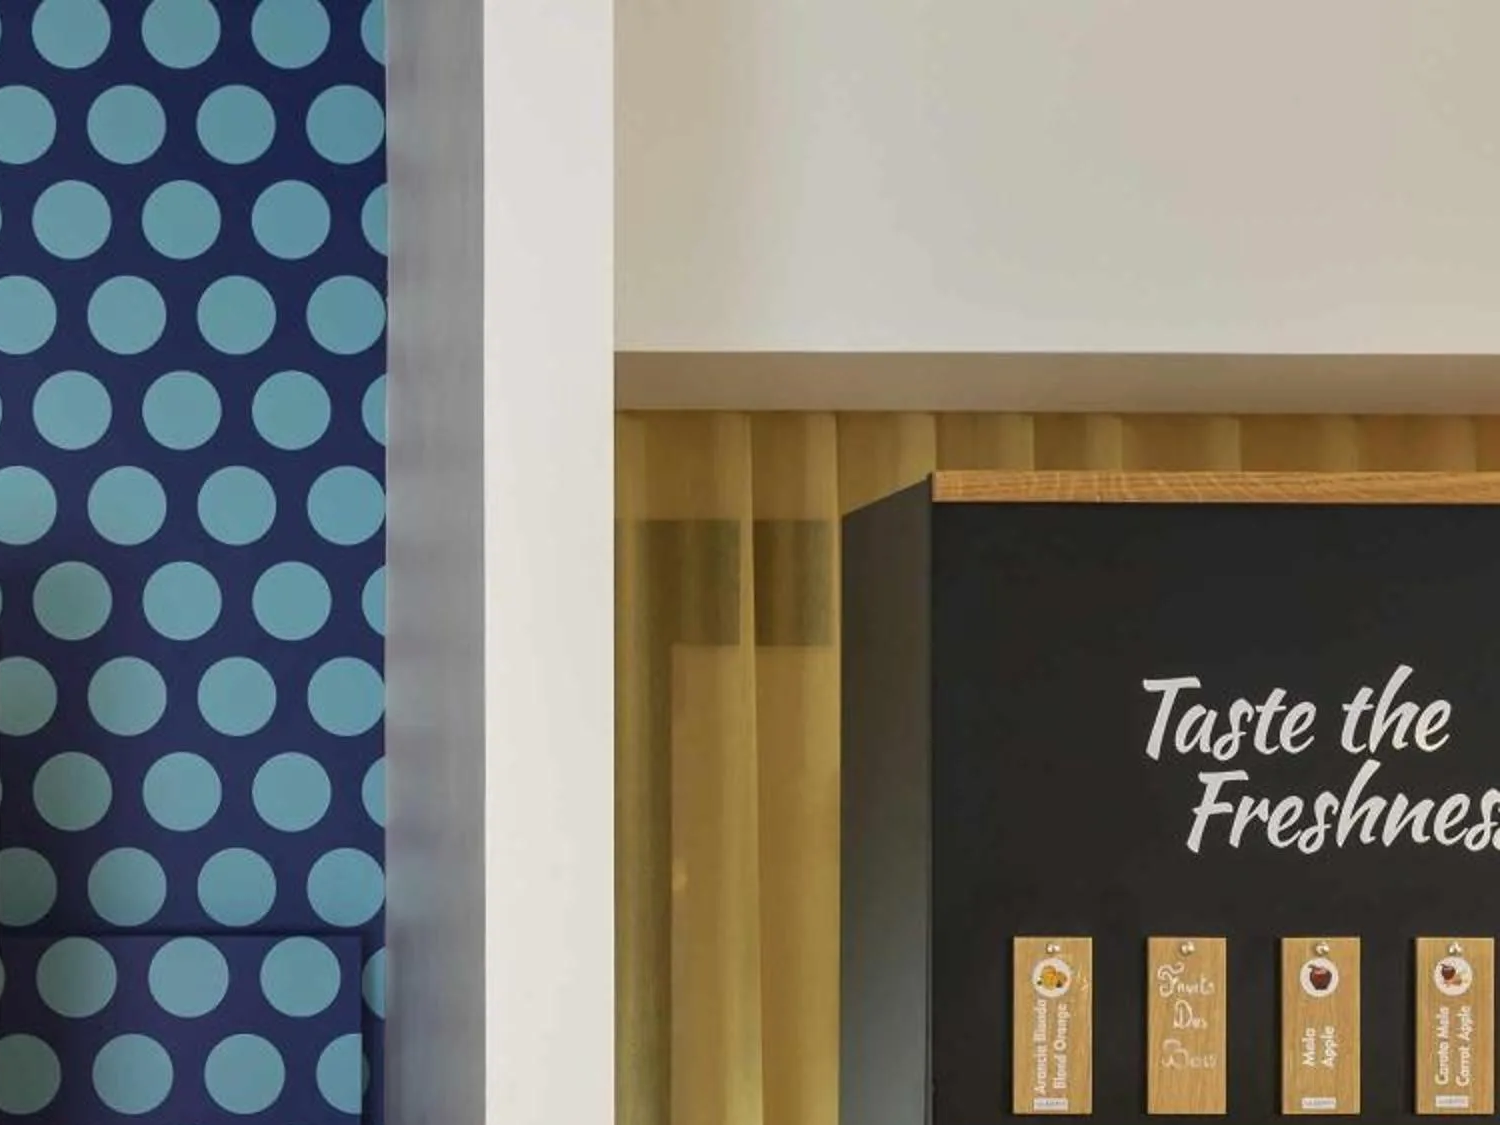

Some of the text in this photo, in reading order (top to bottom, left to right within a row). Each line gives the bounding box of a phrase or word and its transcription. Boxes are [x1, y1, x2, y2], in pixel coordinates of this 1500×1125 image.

[1142, 664, 1452, 761] Taste the
[1053, 1003, 1070, 1051] Orange
[1320, 1025, 1339, 1069] Apple
